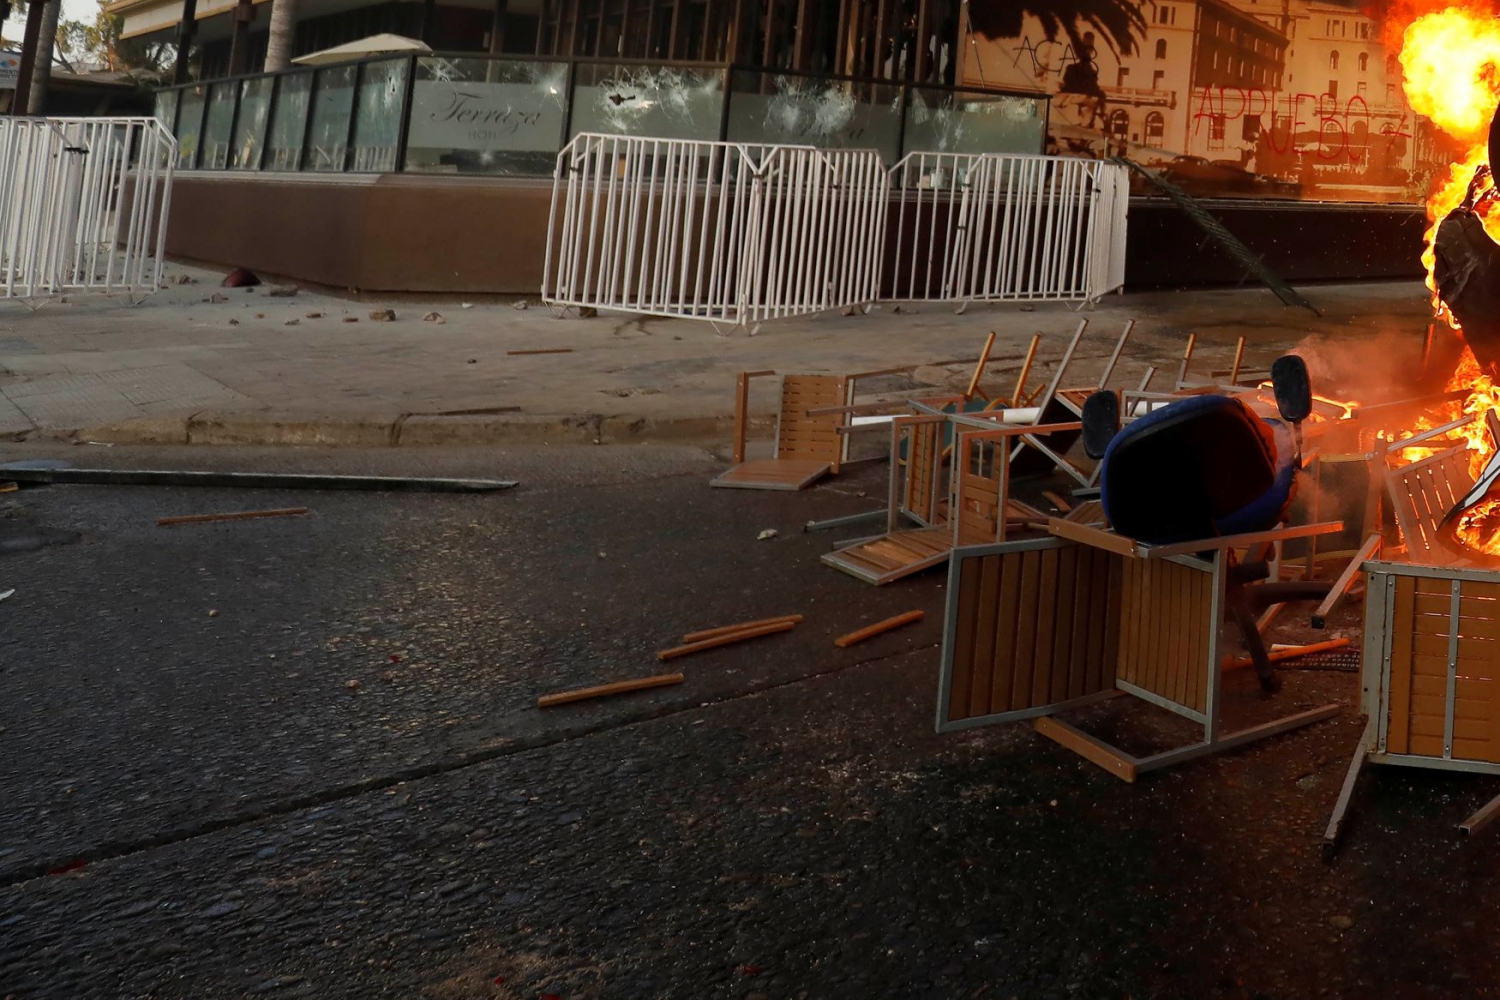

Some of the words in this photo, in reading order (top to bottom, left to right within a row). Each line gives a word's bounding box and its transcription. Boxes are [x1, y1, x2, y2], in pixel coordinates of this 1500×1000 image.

[1012, 35, 1099, 77] ACAB
[431, 91, 541, 134] Terraza
[1194, 85, 1369, 161] APRUEBO
